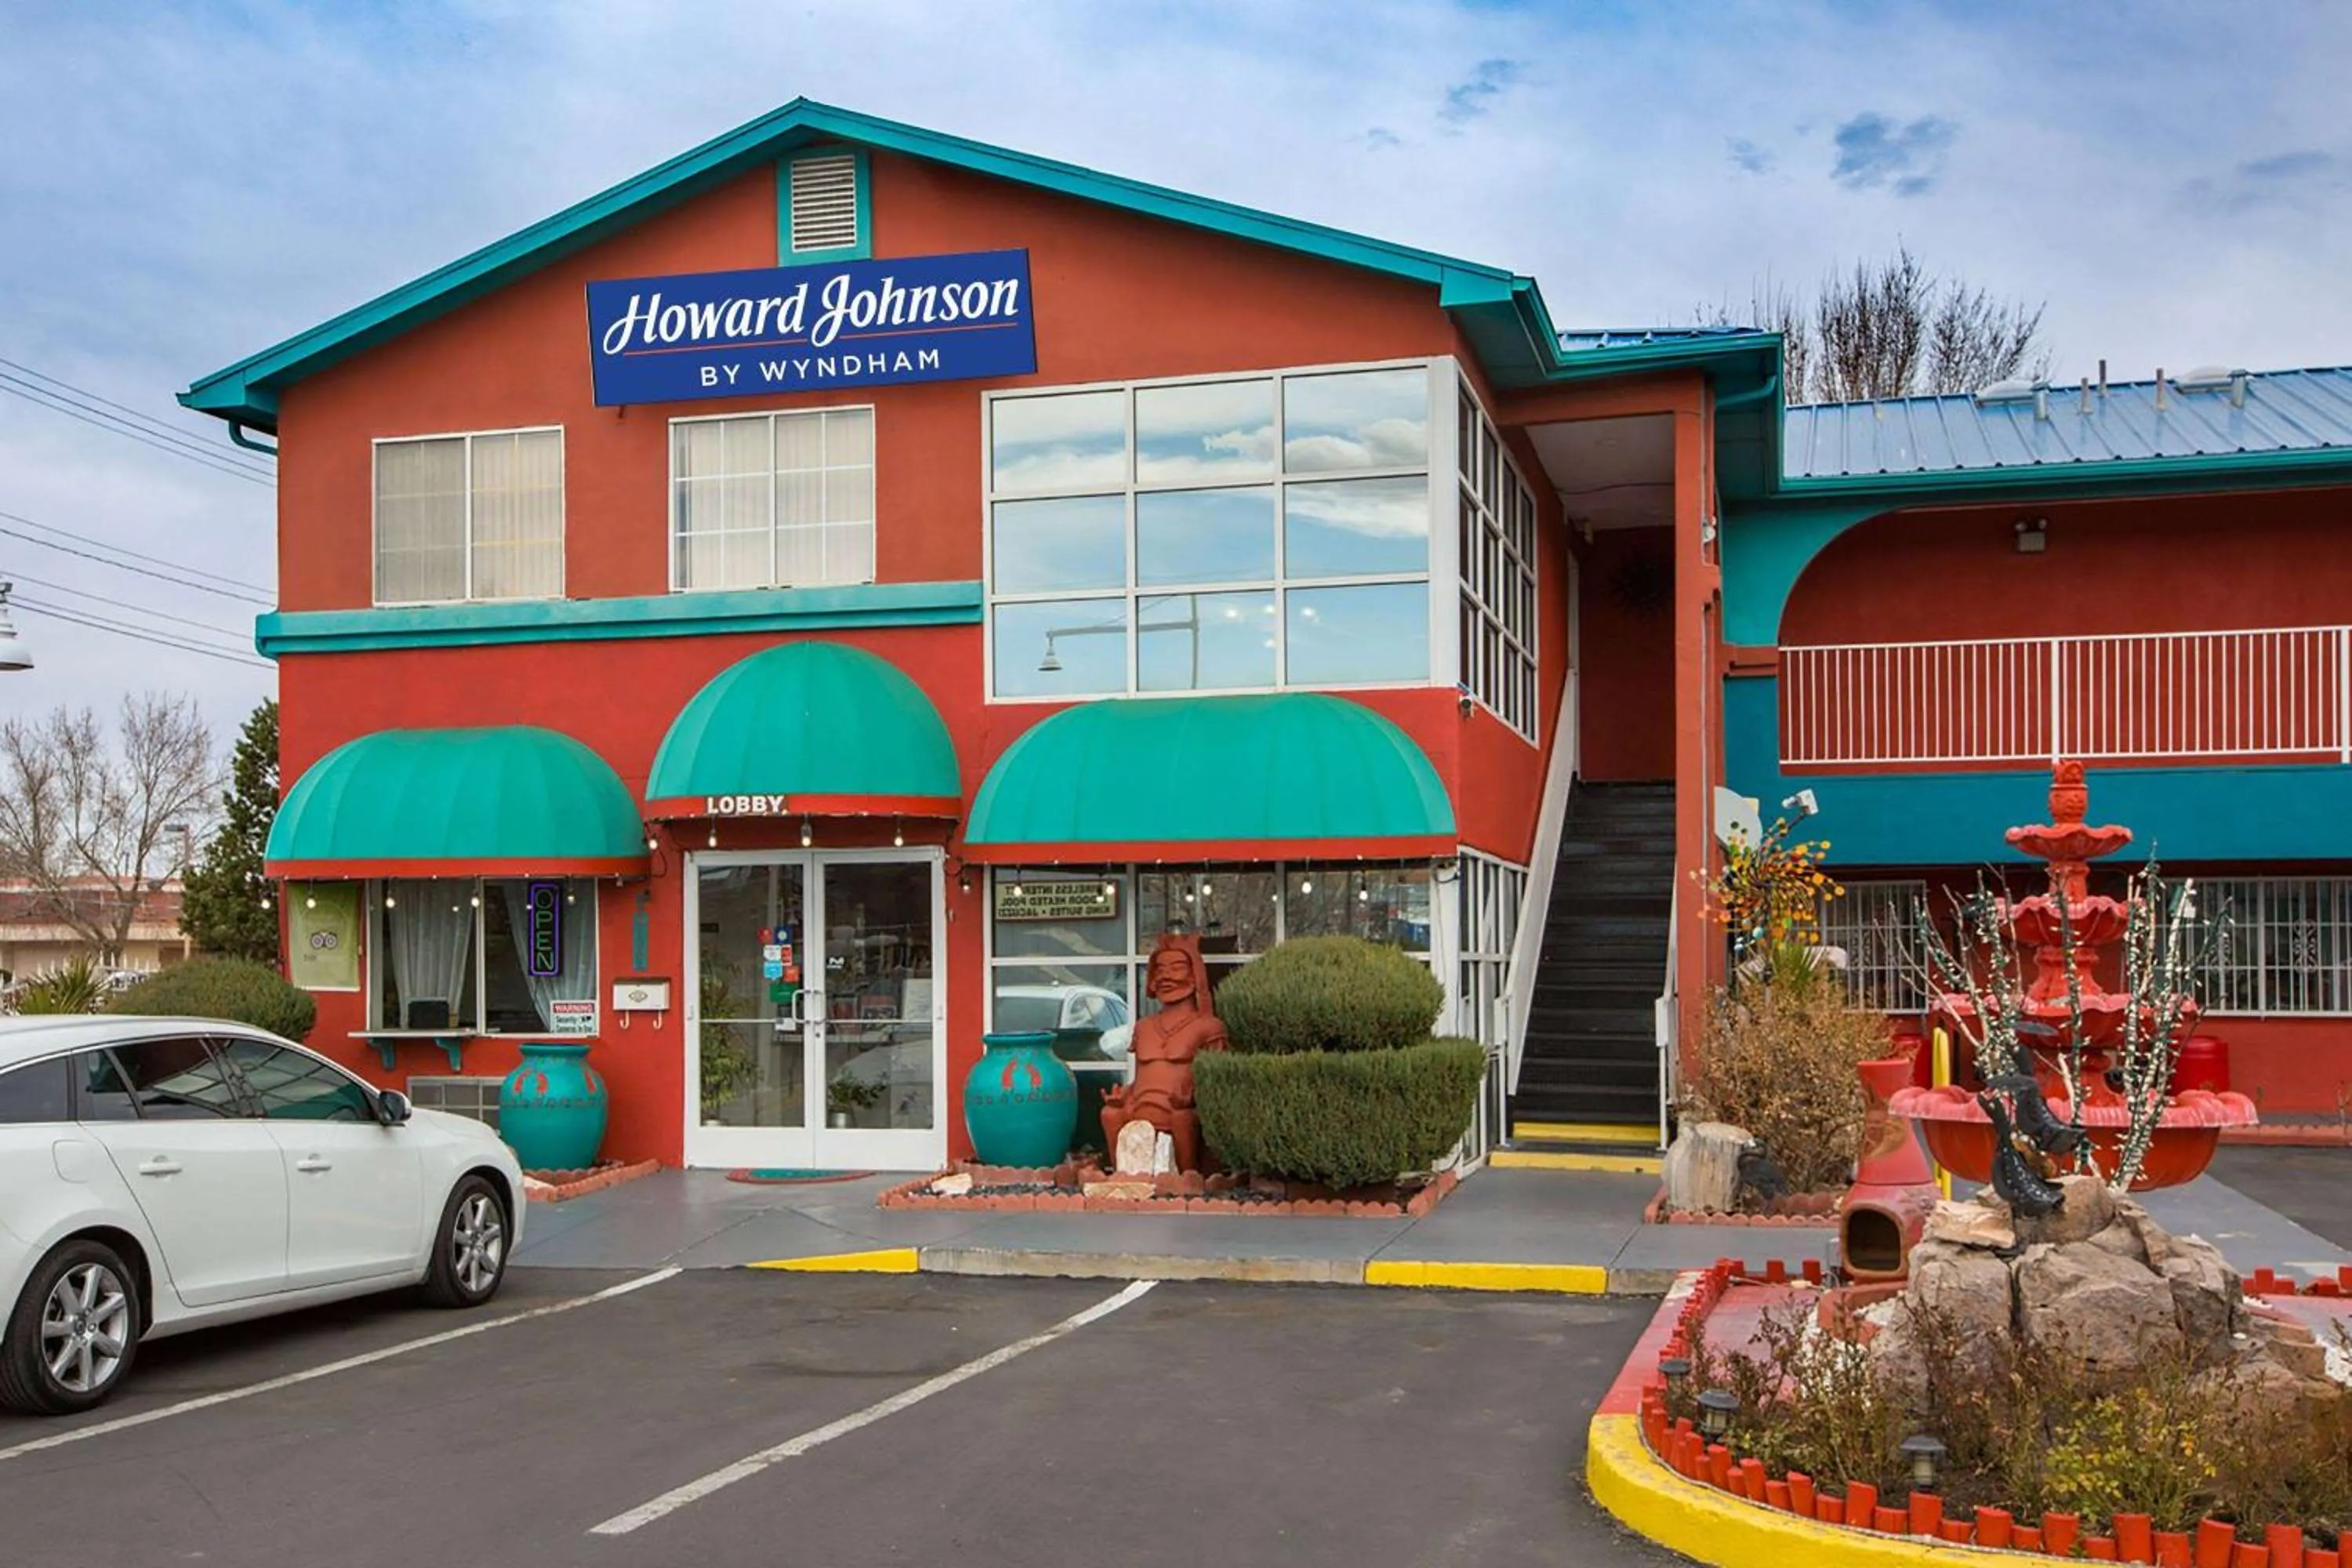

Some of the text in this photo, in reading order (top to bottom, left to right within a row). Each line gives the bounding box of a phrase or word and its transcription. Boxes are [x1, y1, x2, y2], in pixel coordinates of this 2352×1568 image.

[603, 274, 1019, 355] Howard Johnson
[701, 349, 940, 387] BY WYNDHAM
[707, 796, 784, 814] LOBBY
[535, 888, 554, 971] OPEN
